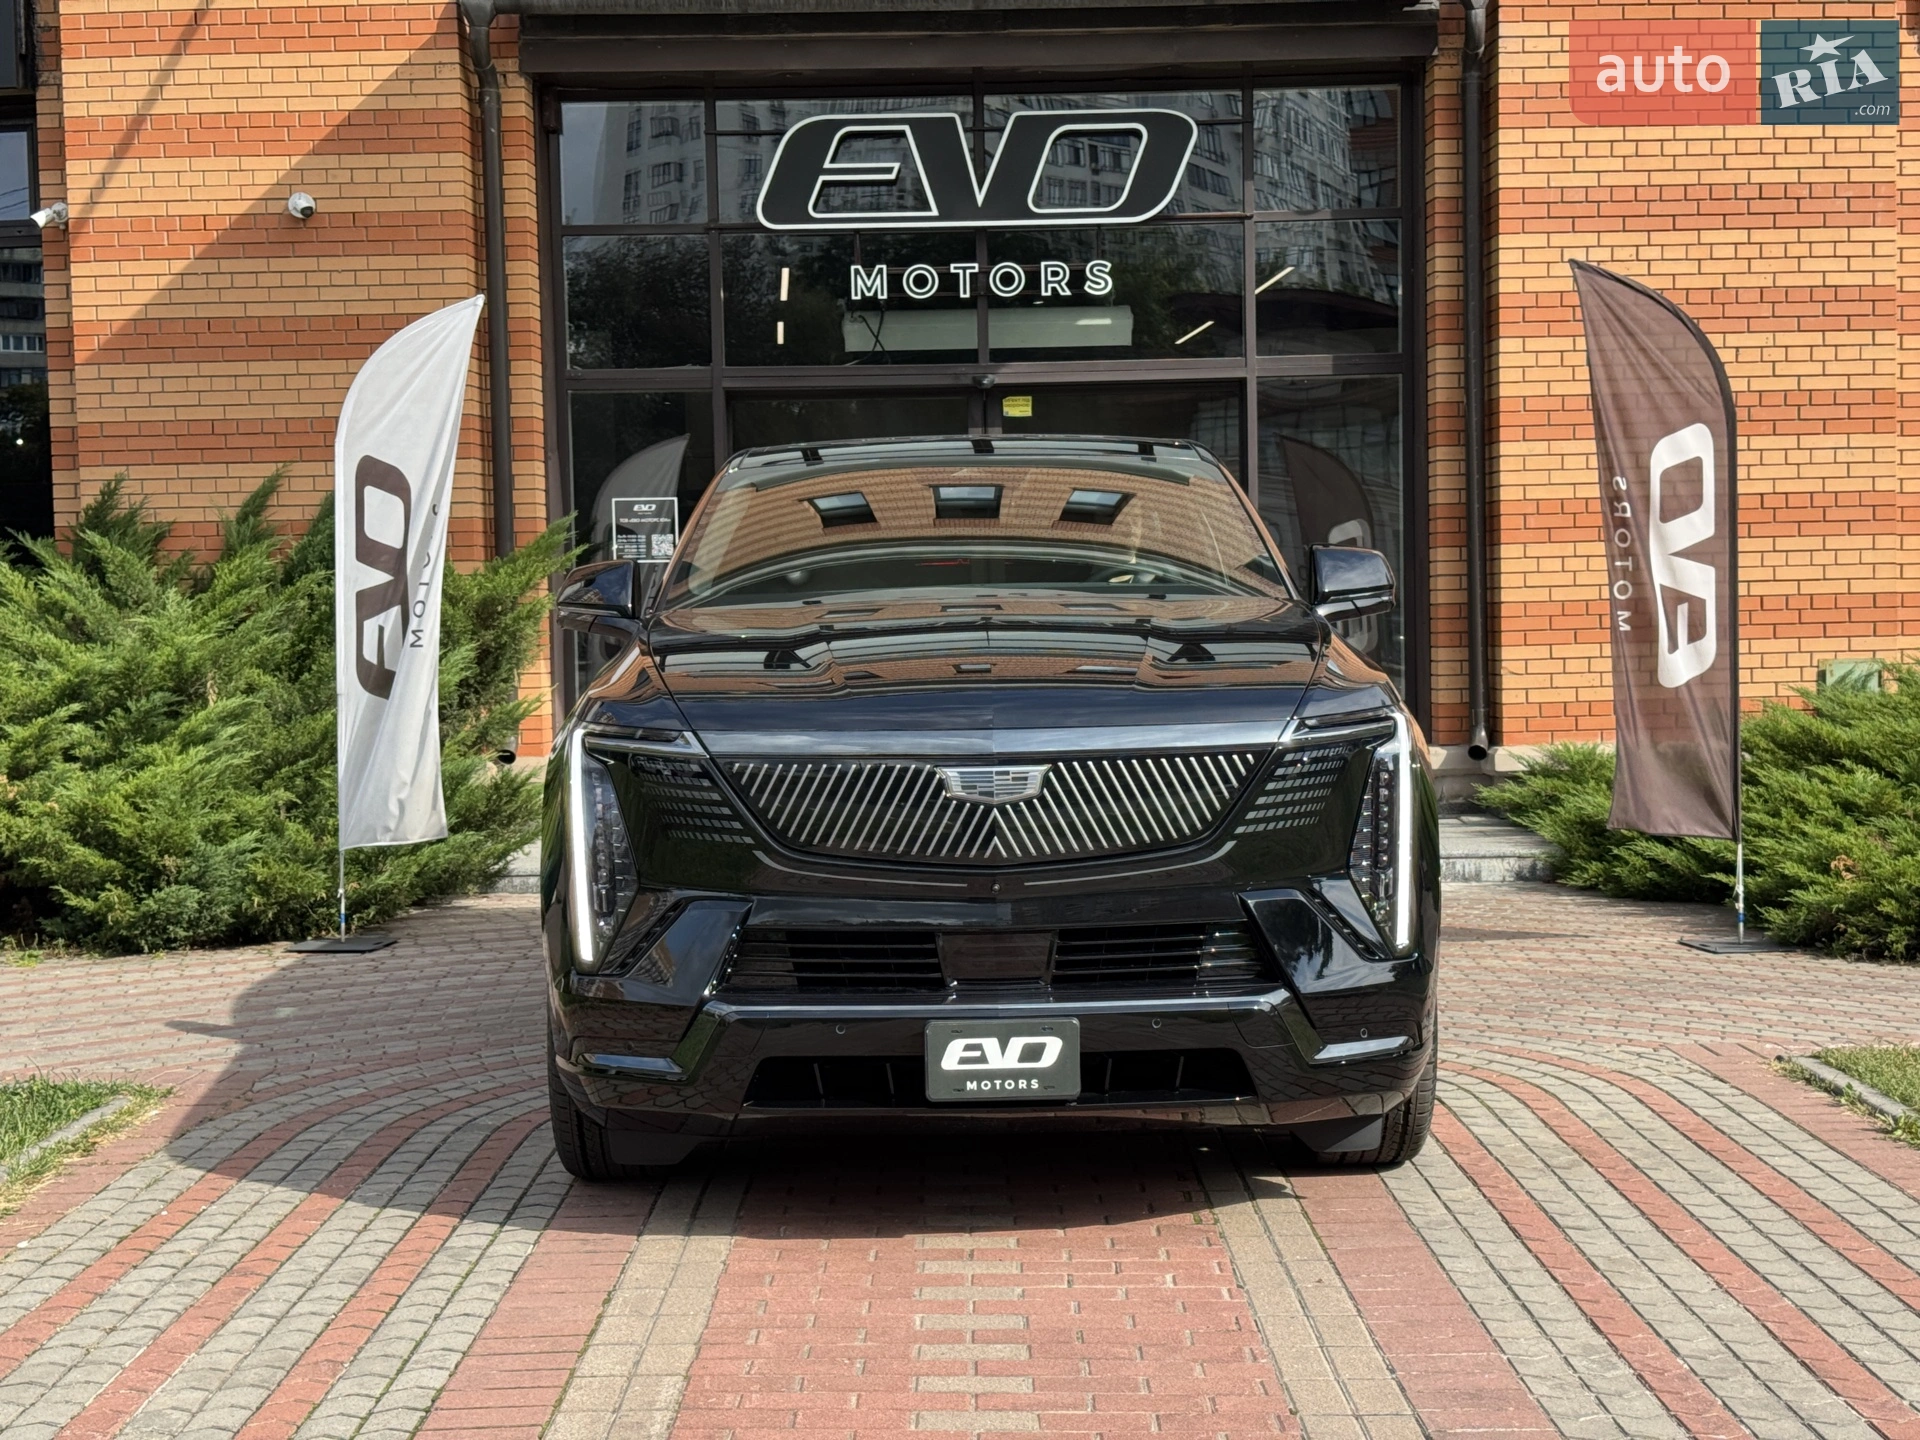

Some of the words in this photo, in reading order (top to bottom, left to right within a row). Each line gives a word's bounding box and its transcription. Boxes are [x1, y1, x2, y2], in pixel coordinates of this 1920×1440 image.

[756, 108, 1198, 230] EVO
[850, 260, 1113, 299] MOTORS
[355, 454, 412, 700] EVO
[940, 1036, 1063, 1070] EVO
[966, 1079, 1039, 1091] MOTORS
